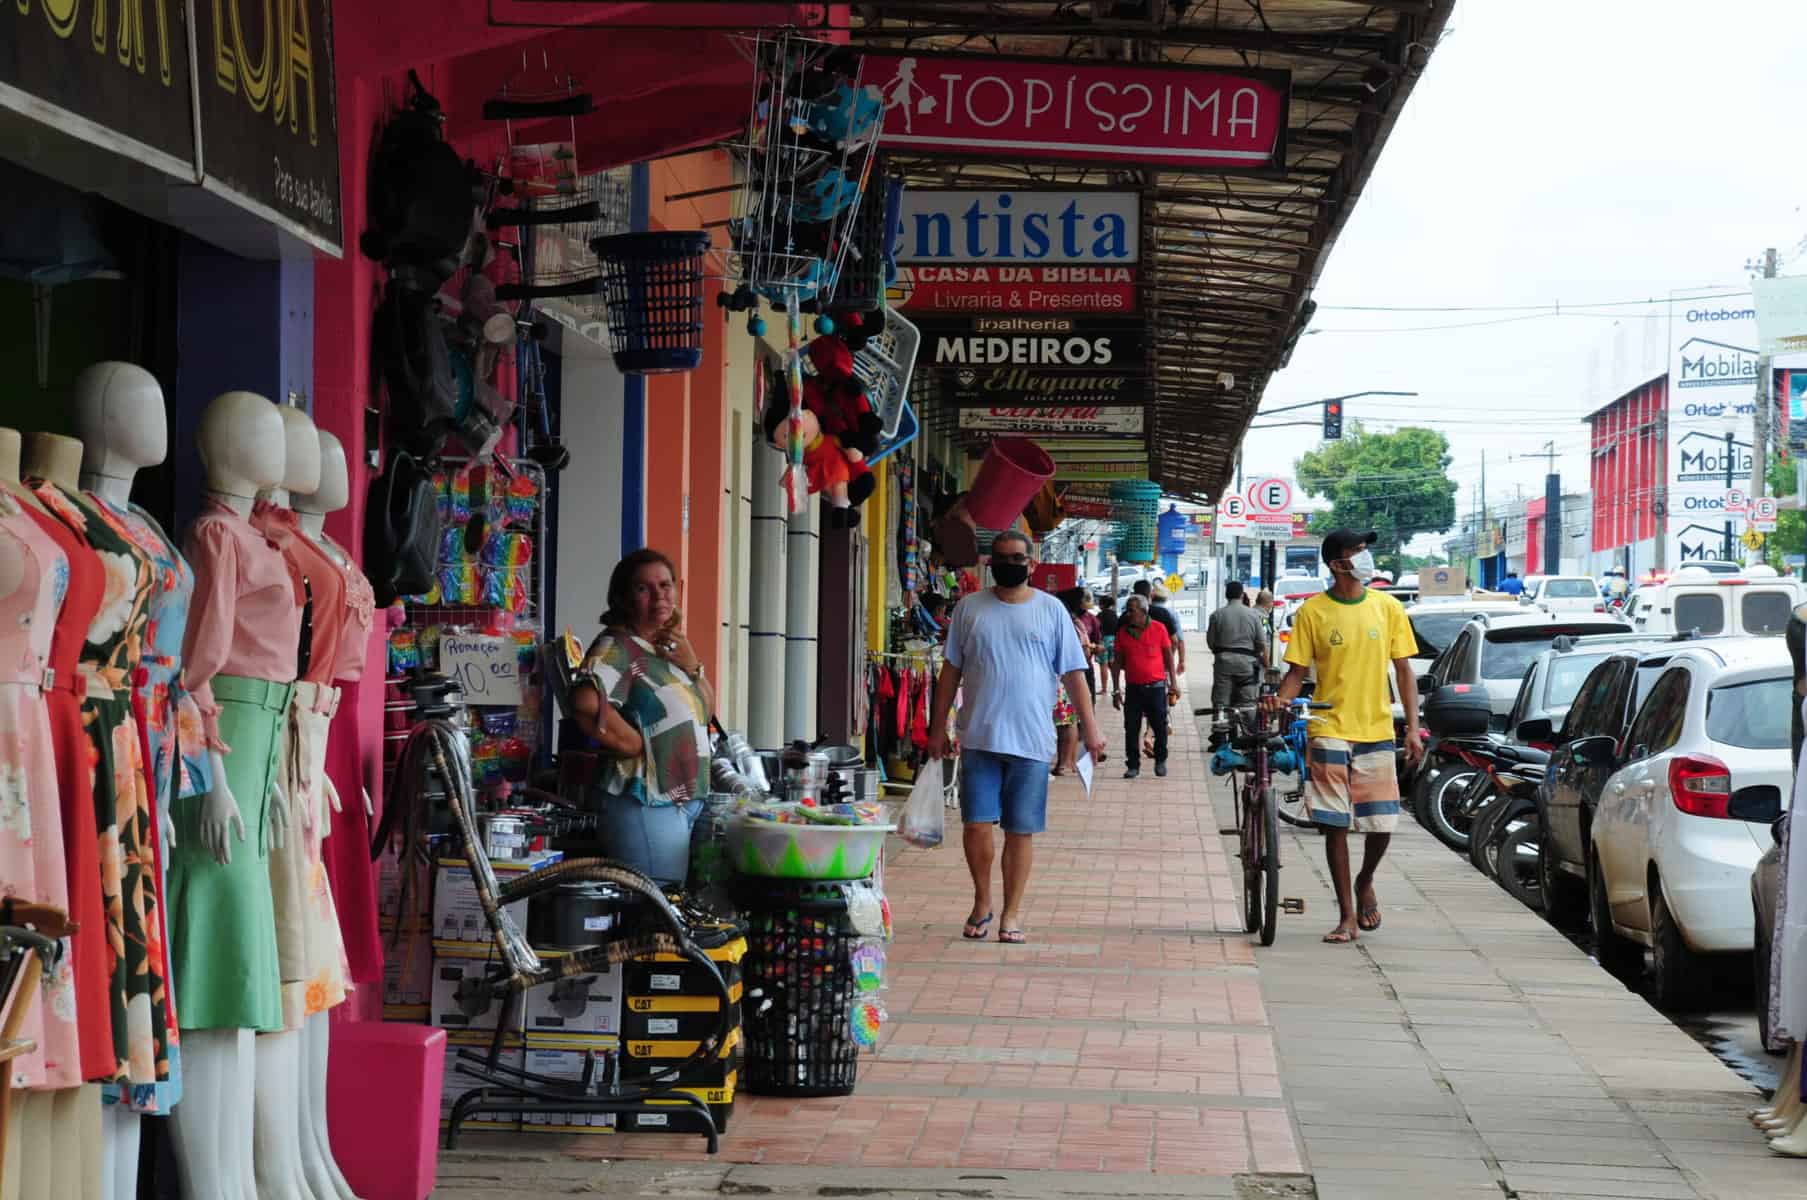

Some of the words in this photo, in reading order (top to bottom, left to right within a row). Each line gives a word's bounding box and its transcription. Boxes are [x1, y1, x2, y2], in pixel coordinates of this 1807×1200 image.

[939, 74, 1259, 139] TOPÍSSIMA
[919, 266, 989, 283] CASA
[1000, 266, 1033, 283] DA
[935, 289, 1003, 308] Livraria
[1008, 289, 1023, 308] &
[1028, 290, 1123, 308] Presentes
[1686, 309, 1755, 323] Ortobom
[935, 337, 1113, 365] MEDEIROS
[1269, 486, 1281, 506] E
[1731, 493, 1739, 503] E
[1230, 500, 1240, 515] E
[1761, 502, 1770, 513] E
[634, 999, 652, 1010] CAT
[634, 1045, 652, 1056] CAT
[707, 1090, 725, 1102] CAT
